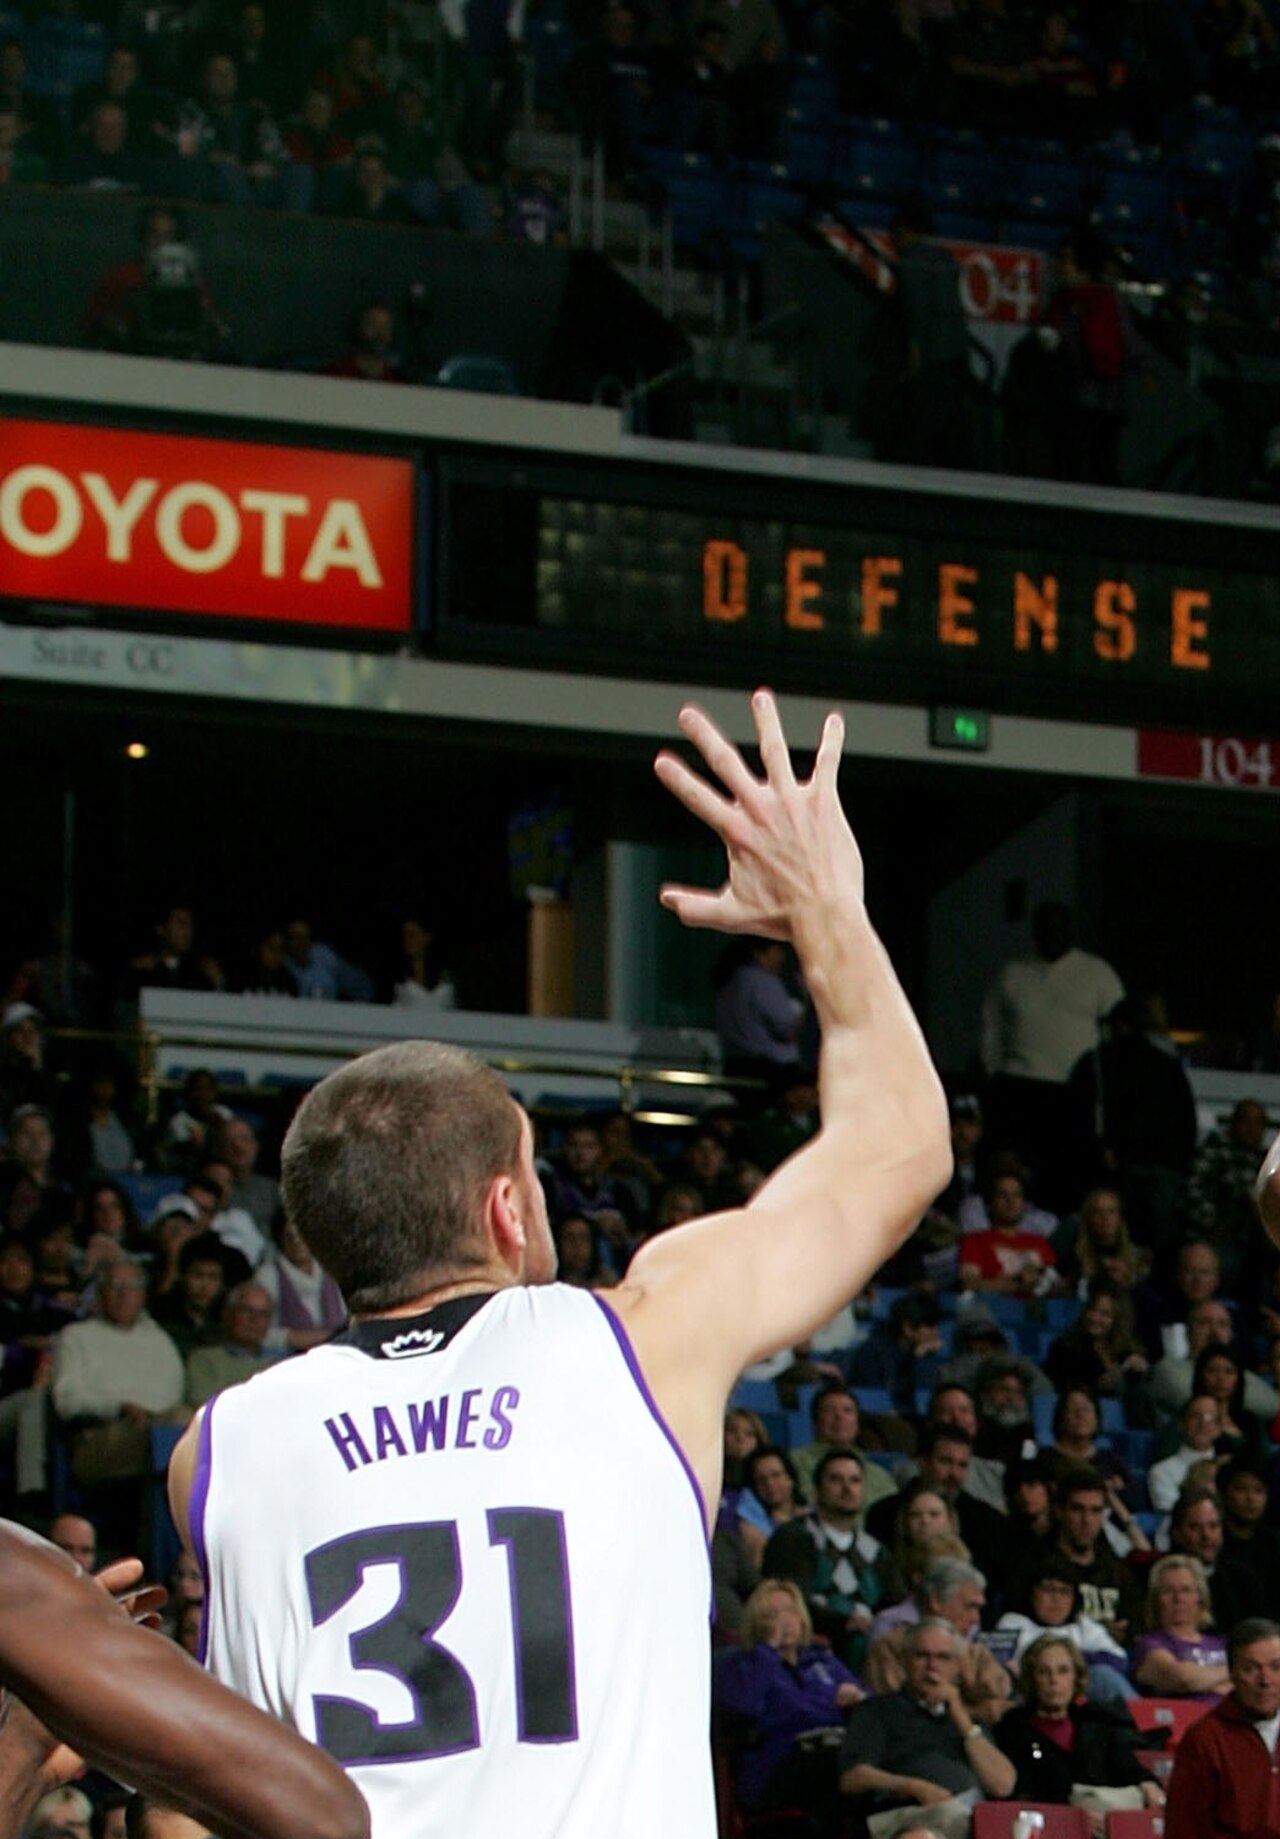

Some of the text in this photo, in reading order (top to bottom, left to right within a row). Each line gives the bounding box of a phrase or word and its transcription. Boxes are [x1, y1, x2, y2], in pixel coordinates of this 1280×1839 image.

[0, 463, 384, 589] OYOTA
[702, 538, 1212, 668] DEFENSE
[1200, 737, 1275, 786] 104
[323, 1385, 521, 1473] HAWES
[303, 1505, 580, 1769] 31
